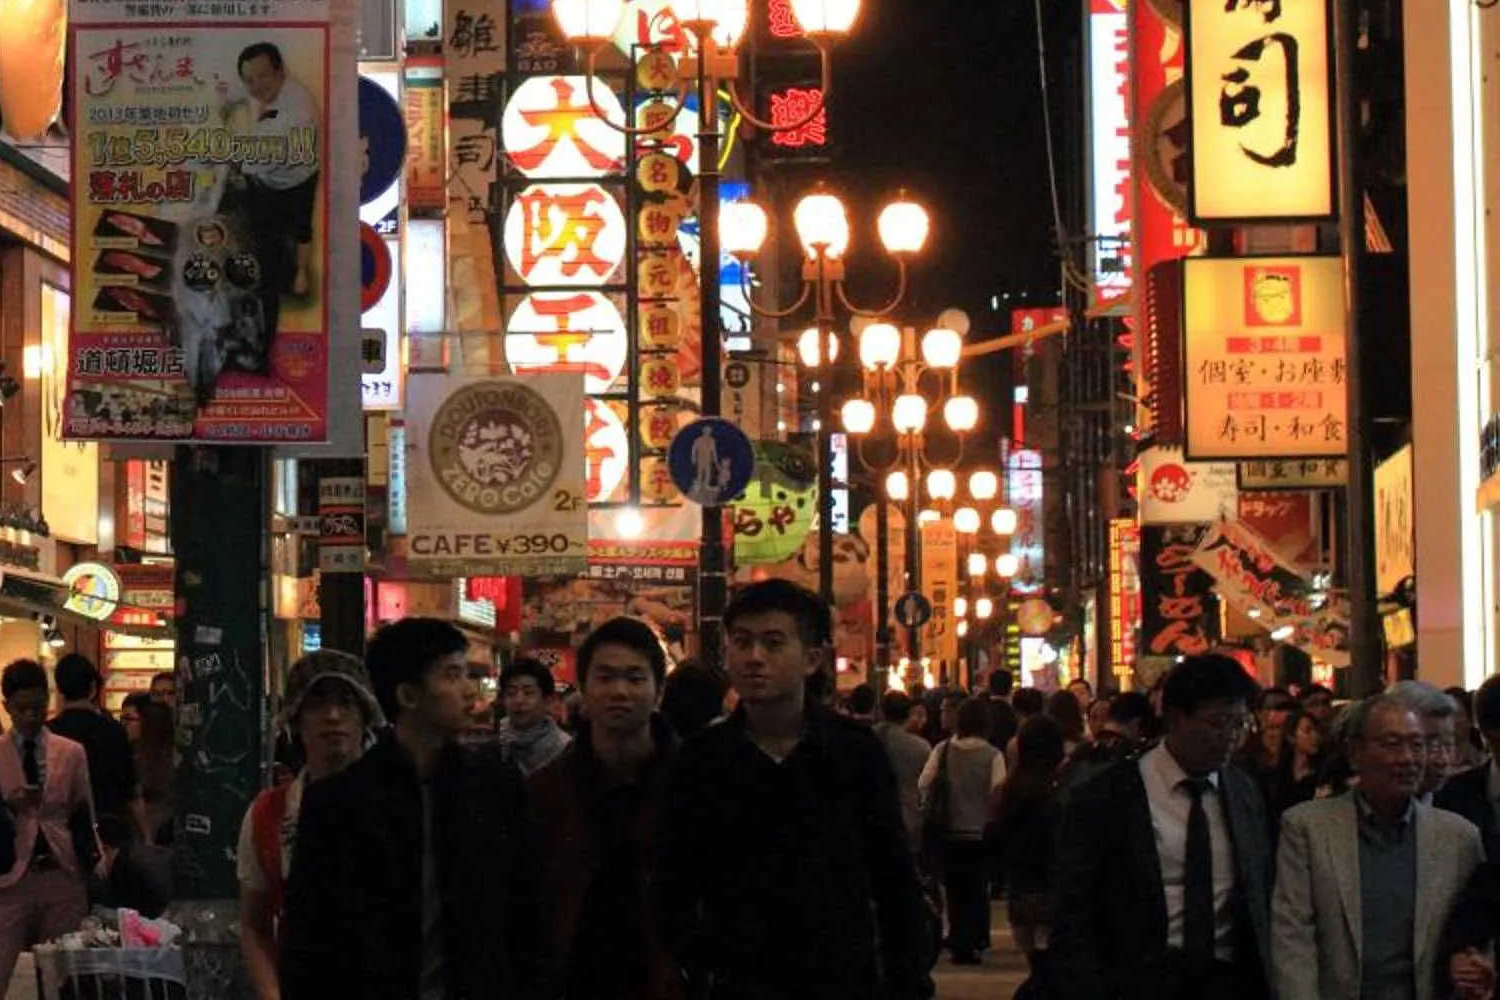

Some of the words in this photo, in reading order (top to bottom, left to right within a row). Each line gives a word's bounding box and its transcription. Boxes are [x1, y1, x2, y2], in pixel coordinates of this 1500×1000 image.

[77, 347, 186, 377] 道頓堀店
[442, 462, 499, 507] ZERO
[411, 534, 491, 554] CAFE
